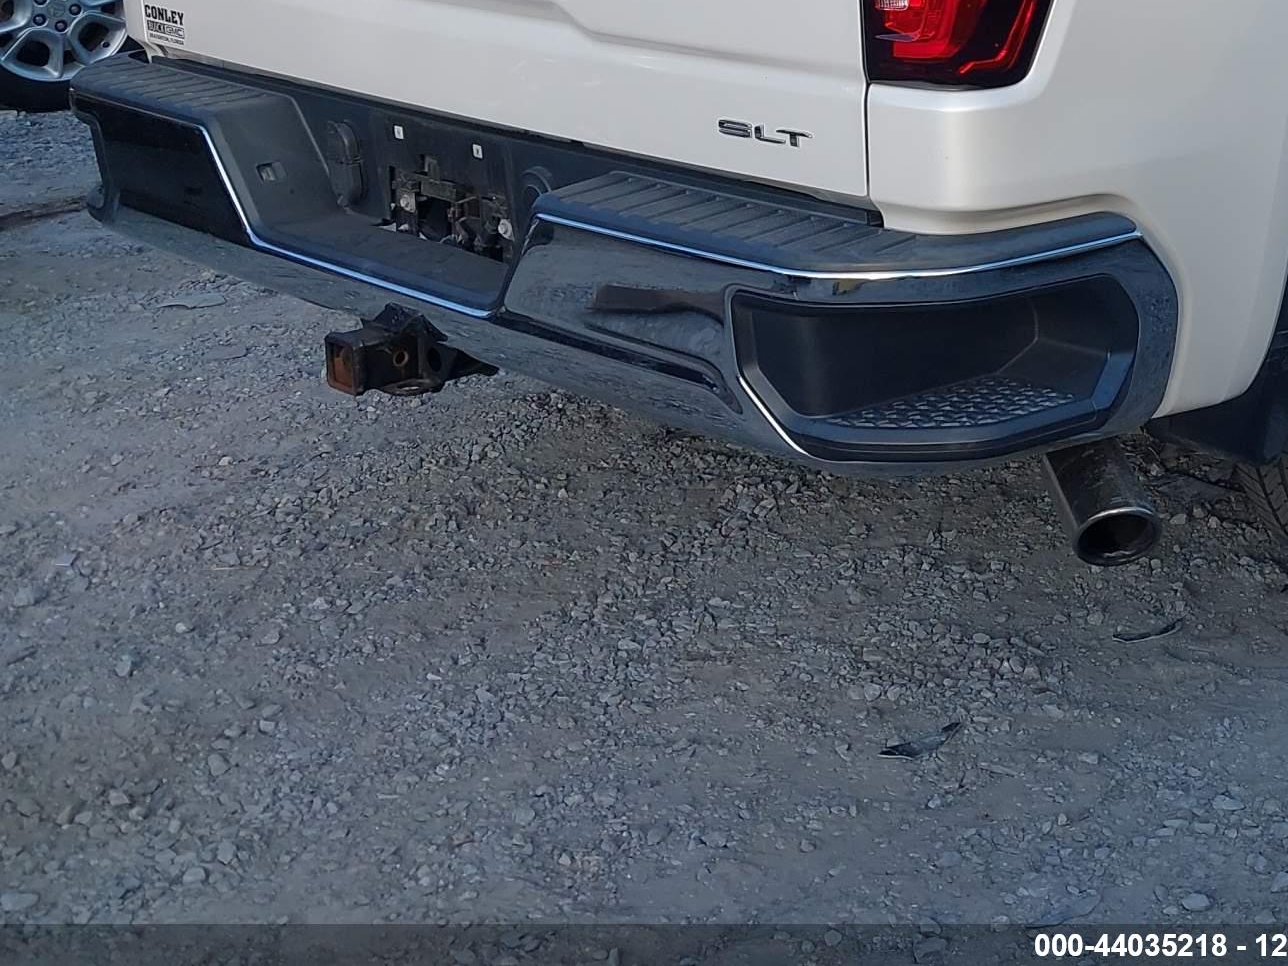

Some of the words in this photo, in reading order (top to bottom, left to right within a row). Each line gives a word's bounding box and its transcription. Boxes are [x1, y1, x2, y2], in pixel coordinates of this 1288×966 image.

[144, 4, 184, 26] CONLEY
[148, 20, 166, 34] BUICK
[166, 24, 185, 38] GMC
[718, 118, 814, 148] SLT
